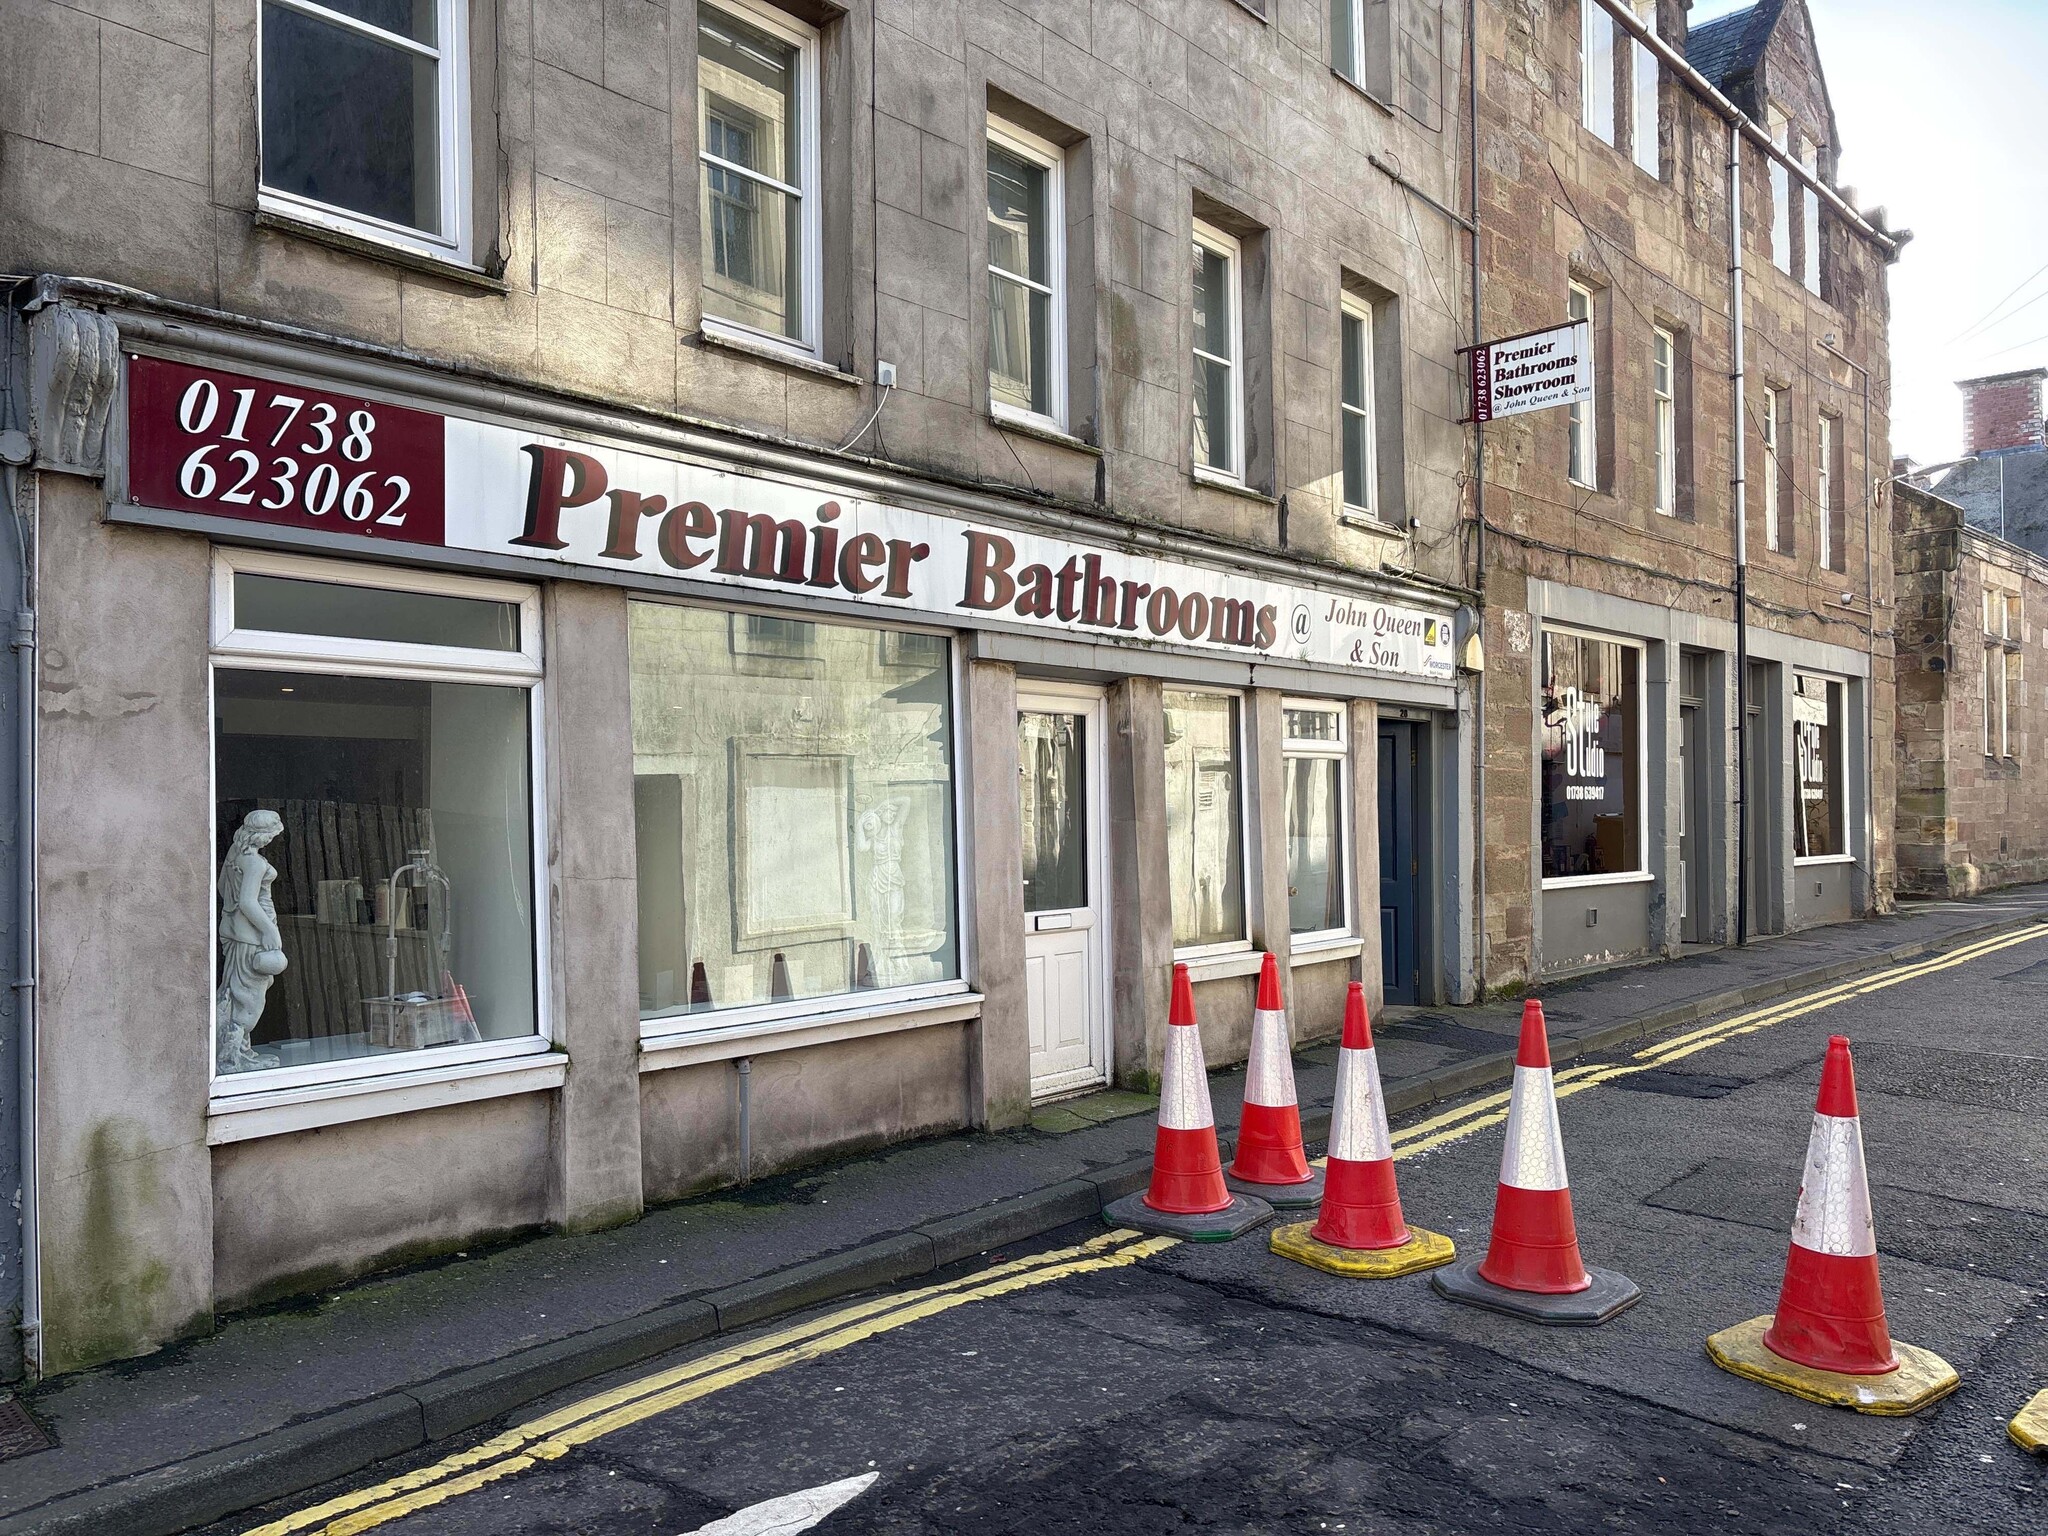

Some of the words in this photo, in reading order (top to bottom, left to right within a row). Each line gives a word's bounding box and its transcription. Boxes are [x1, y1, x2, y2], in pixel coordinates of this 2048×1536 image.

[1476, 350, 1487, 387] 623062
[1494, 342, 1555, 365] Premier
[1494, 354, 1578, 383] Bathrooms
[1494, 374, 1576, 400] Showroom
[1504, 400, 1527, 410] John
[1529, 394, 1559, 406] Queen
[1562, 390, 1569, 398] &
[1572, 386, 1590, 396] Son
[1478, 389, 1488, 420] 01738
[176, 379, 376, 462] 01738
[176, 444, 411, 527] 623062
[508, 443, 930, 599] Premier
[955, 529, 1277, 650] Bathrooms
[1291, 604, 1312, 645] @
[1325, 599, 1367, 628] John
[1373, 607, 1421, 637] Queen
[1350, 639, 1364, 663] &
[1369, 641, 1399, 667] Son
[1566, 785, 1584, 800] 01738
